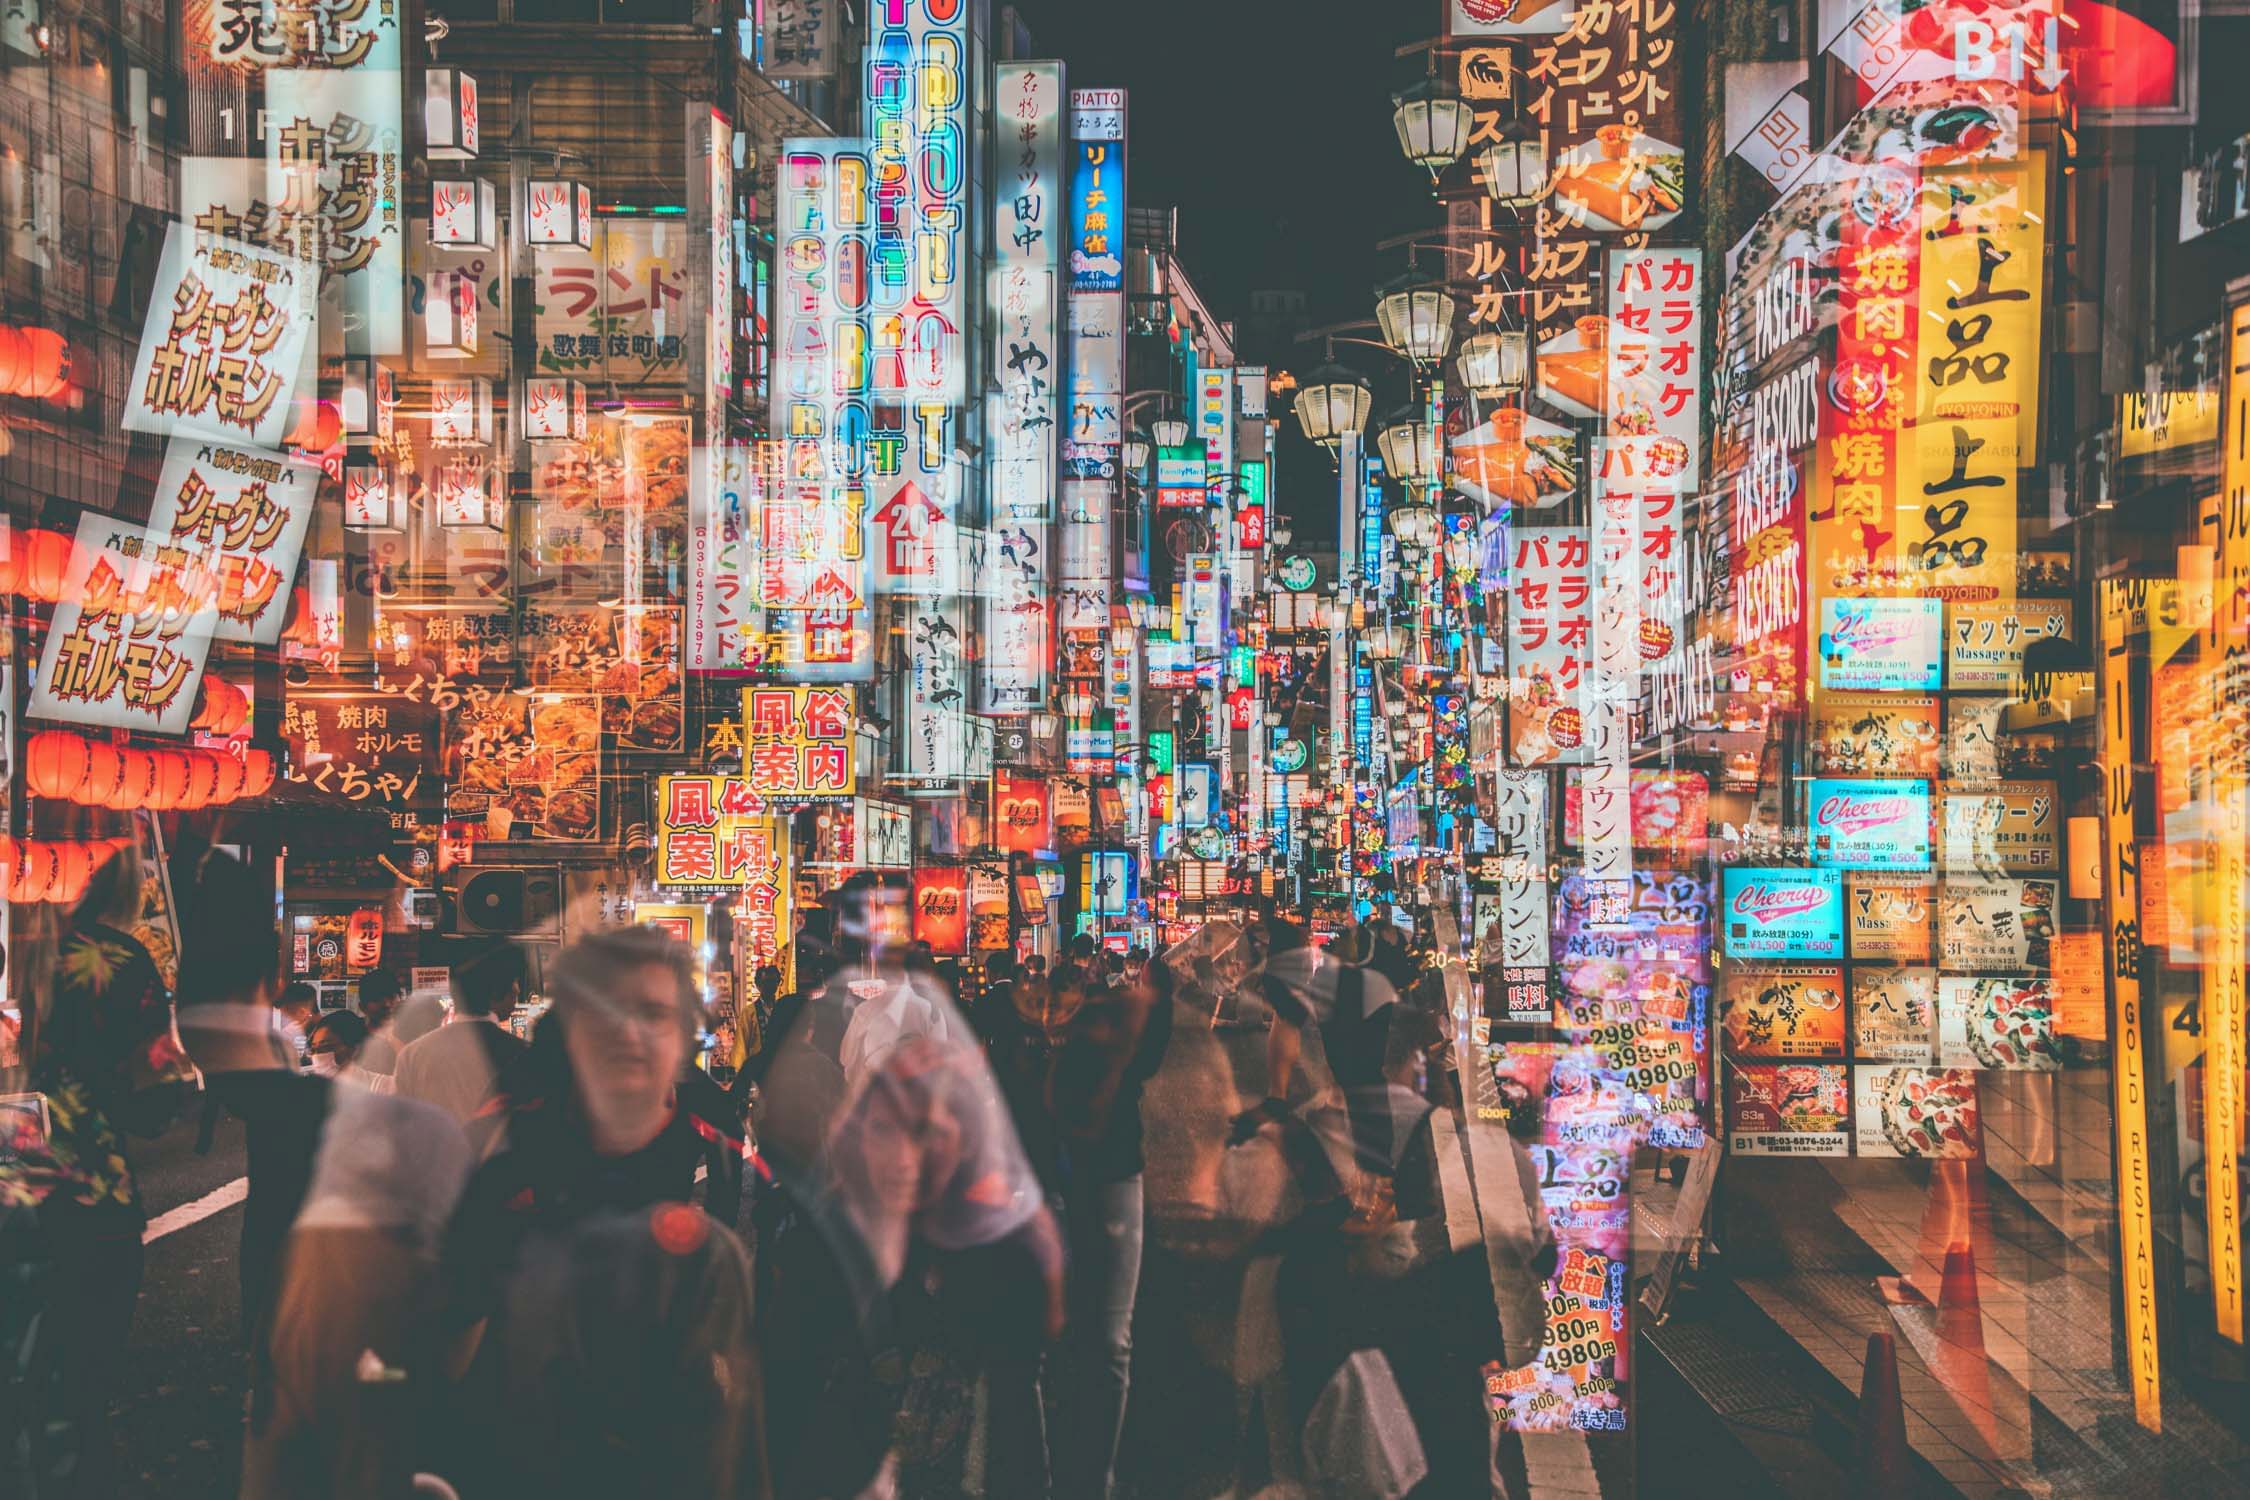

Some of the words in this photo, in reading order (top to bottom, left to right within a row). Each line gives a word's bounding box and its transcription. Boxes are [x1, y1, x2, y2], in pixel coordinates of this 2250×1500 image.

[1954, 21, 2025, 81] B1
[1072, 92, 1120, 107] PIATTO
[1084, 146, 1108, 253] リーチ麻雀
[1754, 250, 1812, 363] PASELA
[1852, 244, 1909, 342] 焼肉
[1946, 238, 2032, 388] 上品
[1658, 257, 1696, 419] カラオケ
[1754, 356, 1820, 456] RESORTS
[2152, 426, 2169, 444] YEN
[1101, 464, 1114, 475] 2F
[1160, 467, 1204, 477] FamilyMart
[1830, 432, 1885, 526] 焼肉
[891, 503, 928, 537] 20
[1513, 537, 1551, 652] パセラ
[1736, 541, 1801, 650] RESORTS
[1093, 616, 1108, 625] 2F
[1556, 534, 1593, 691] カラオケ
[2130, 609, 2147, 626] YEN
[1955, 615, 2066, 647] マッサージ
[1090, 648, 1104, 660] 2F
[1955, 647, 2006, 663] Massage
[48, 623, 195, 724] ホルモン
[336, 704, 388, 729] 焼肉
[752, 690, 849, 739] 風俗
[2036, 701, 2052, 717] YEN
[1009, 735, 1023, 747] 2F
[1068, 737, 1113, 748] FamilyMart
[751, 743, 849, 791] 案内
[924, 779, 949, 790] B1F
[1908, 785, 1925, 796] 4F
[666, 778, 768, 828] 風俗
[2029, 849, 2051, 865] 5F
[1823, 873, 1840, 884] 4F
[1734, 885, 1830, 914] Cheerup
[2173, 999, 2202, 1037] 4
[2124, 1002, 2139, 1104] GOLD
[1624, 1061, 1698, 1091] 4980円
[1735, 1137, 1753, 1149] B1
[2216, 1043, 2237, 1312] RESTAURANT
[1562, 1248, 1608, 1277] 食べ
[2130, 1131, 2156, 1401] RESTAURANT
[1559, 1271, 1606, 1300] 放題
[1588, 1298, 1609, 1310] 税別
[1543, 1340, 1617, 1374] 4980円
[1528, 1392, 1564, 1413] 800円
[1572, 1377, 1617, 1401] 1500円
[1568, 1407, 1626, 1432] 焼き鳥
